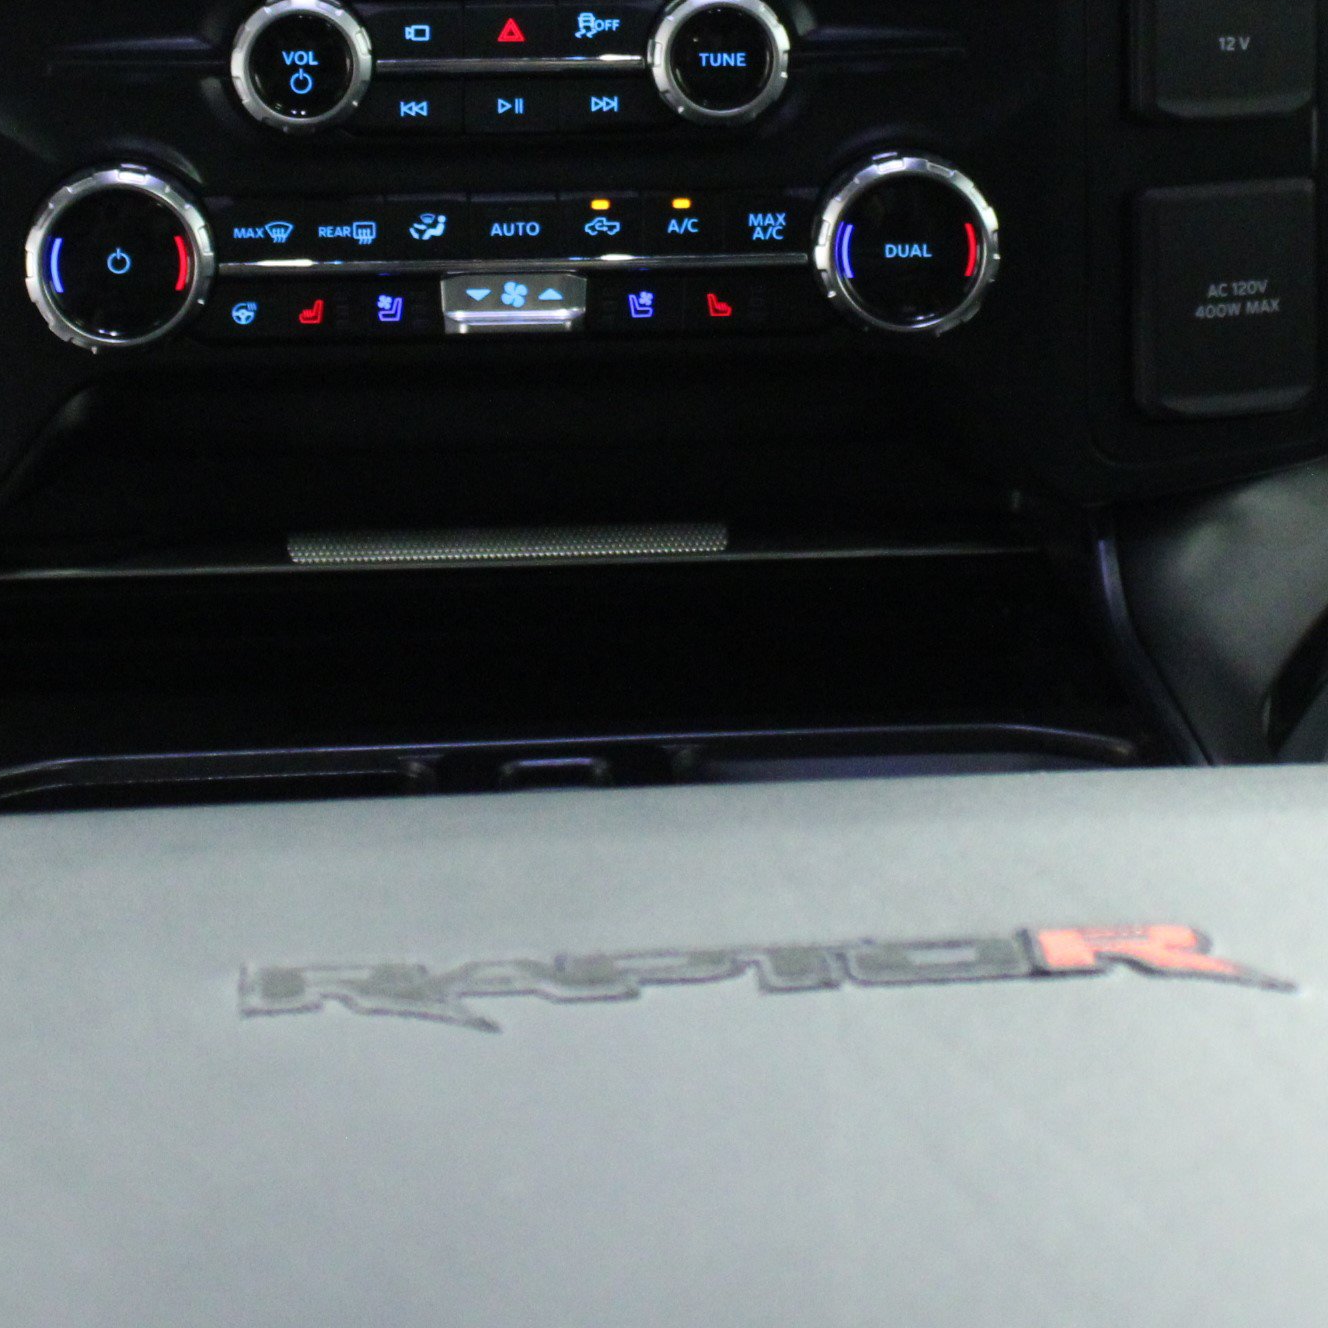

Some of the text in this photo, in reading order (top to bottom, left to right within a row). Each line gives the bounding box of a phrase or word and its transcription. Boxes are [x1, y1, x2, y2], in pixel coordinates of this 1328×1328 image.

[596, 18, 620, 32] OFF
[282, 51, 318, 65] VOL
[699, 52, 746, 67] TUNE
[667, 219, 699, 234] A/C
[748, 213, 786, 227] MAX
[233, 226, 264, 239] MAX
[318, 226, 350, 238] REAR
[490, 222, 540, 237] AUTO
[752, 225, 784, 241] A/C
[884, 243, 932, 259] DUAL
[1207, 279, 1268, 298] AC 120V
[1195, 298, 1280, 319] 400W MAX
